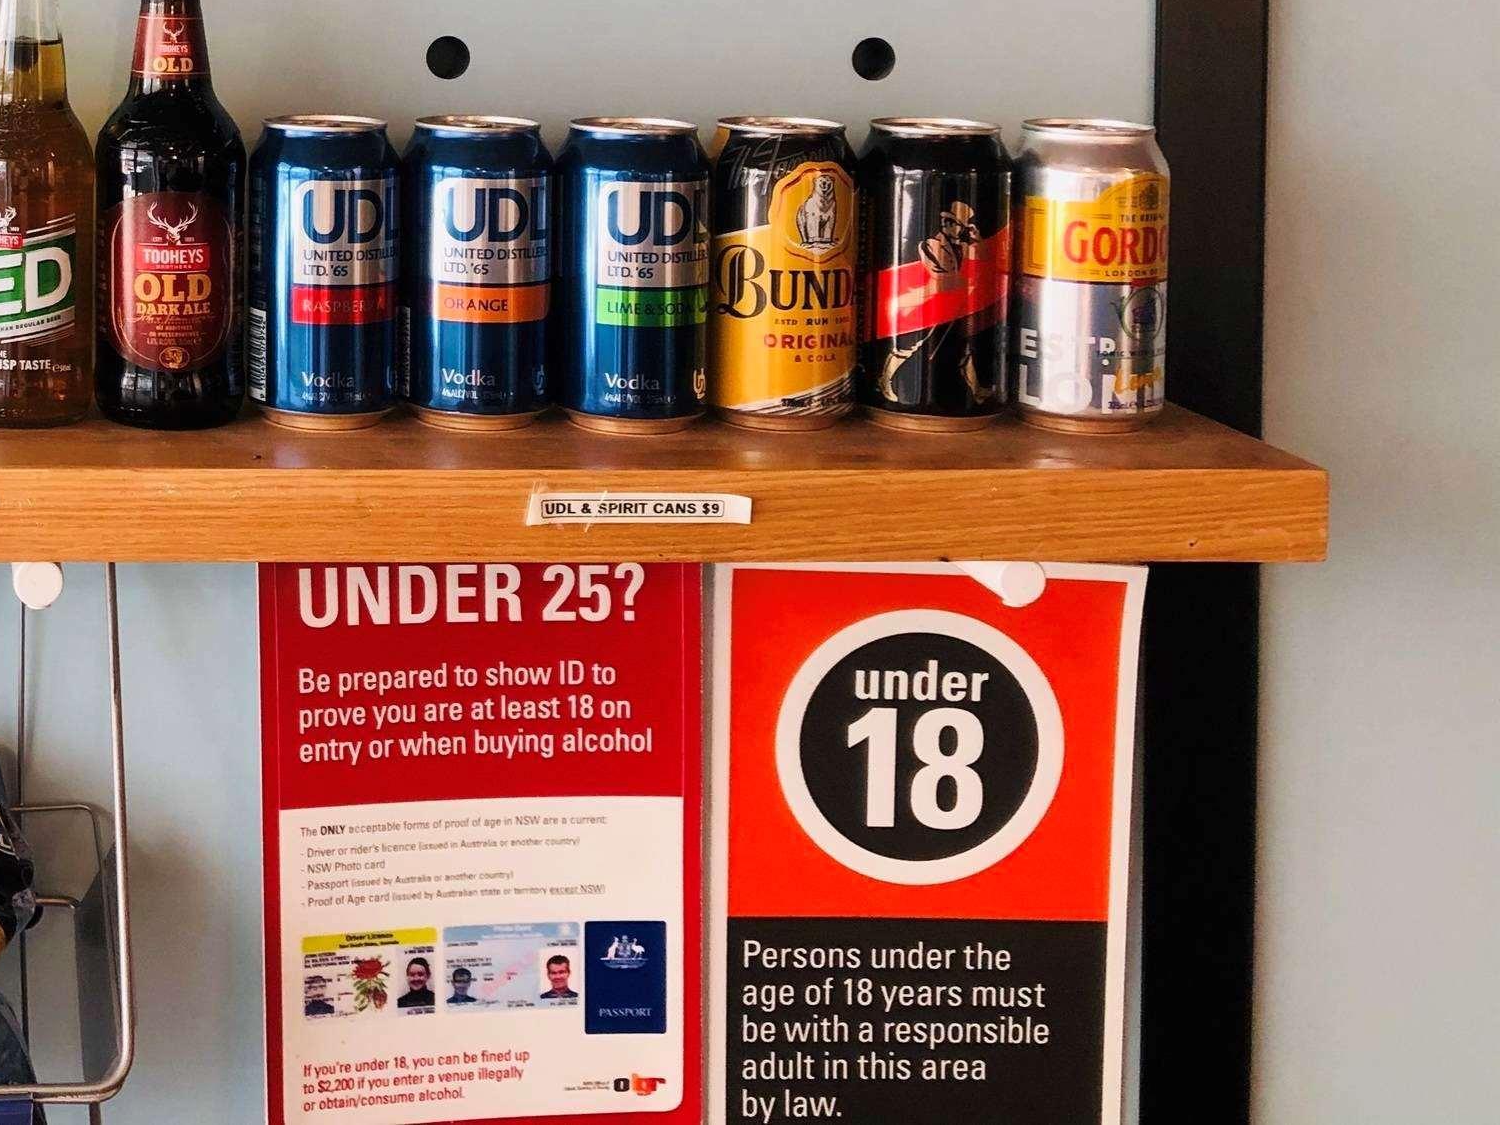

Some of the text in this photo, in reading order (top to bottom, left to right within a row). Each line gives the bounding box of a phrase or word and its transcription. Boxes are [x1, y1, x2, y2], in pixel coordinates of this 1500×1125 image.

[152, 57, 194, 72] OLD
[302, 181, 399, 245] UDL
[445, 186, 548, 244] UDL
[607, 188, 708, 247] UDL
[143, 248, 204, 264] TOOHEYS
[303, 250, 353, 262] UNITED
[444, 247, 494, 261] UNITED
[607, 250, 659, 265] UNITED
[133, 273, 212, 303] OLD
[137, 302, 211, 316] DARK ALE
[444, 297, 509, 313] ORANGE
[607, 300, 641, 315] LIME
[19, 359, 51, 371] TASTE
[301, 371, 355, 389] Vodka
[441, 367, 496, 387] Vodka
[604, 372, 660, 391] Vodka
[545, 502, 720, 515] UDL & SPIRIT CANS $9
[298, 562, 645, 629] UNDER 25?
[298, 660, 616, 697] Be prepared to show ID to
[853, 659, 990, 703] under
[299, 693, 632, 734] prove you are at least 18 on
[299, 727, 653, 766] entry or when buying alcohol
[847, 706, 985, 831] 18
[320, 815, 541, 836] ONLY NSW
[306, 862, 333, 874] NSW
[307, 878, 349, 891] Passport
[347, 894, 366, 907] Age
[743, 939, 1012, 971] Persons under the
[742, 977, 1046, 1013] age of 18 years must
[598, 1006, 653, 1019] PASSPORT
[742, 1015, 1050, 1050] be with a responsible
[303, 1063, 313, 1078] If
[314, 1061, 352, 1079] you're
[355, 1057, 390, 1073] under
[412, 1056, 435, 1071] you
[437, 1053, 460, 1066] can
[463, 1051, 478, 1064] be
[480, 1049, 513, 1062] fined
[515, 1050, 531, 1064] up
[742, 1052, 987, 1081] adult in this area
[303, 1066, 525, 1095] to $2,200 if you enter a venue illegally
[303, 1099, 317, 1113] or
[319, 1091, 416, 1111] obtain/consume
[742, 1088, 843, 1124] by law.
